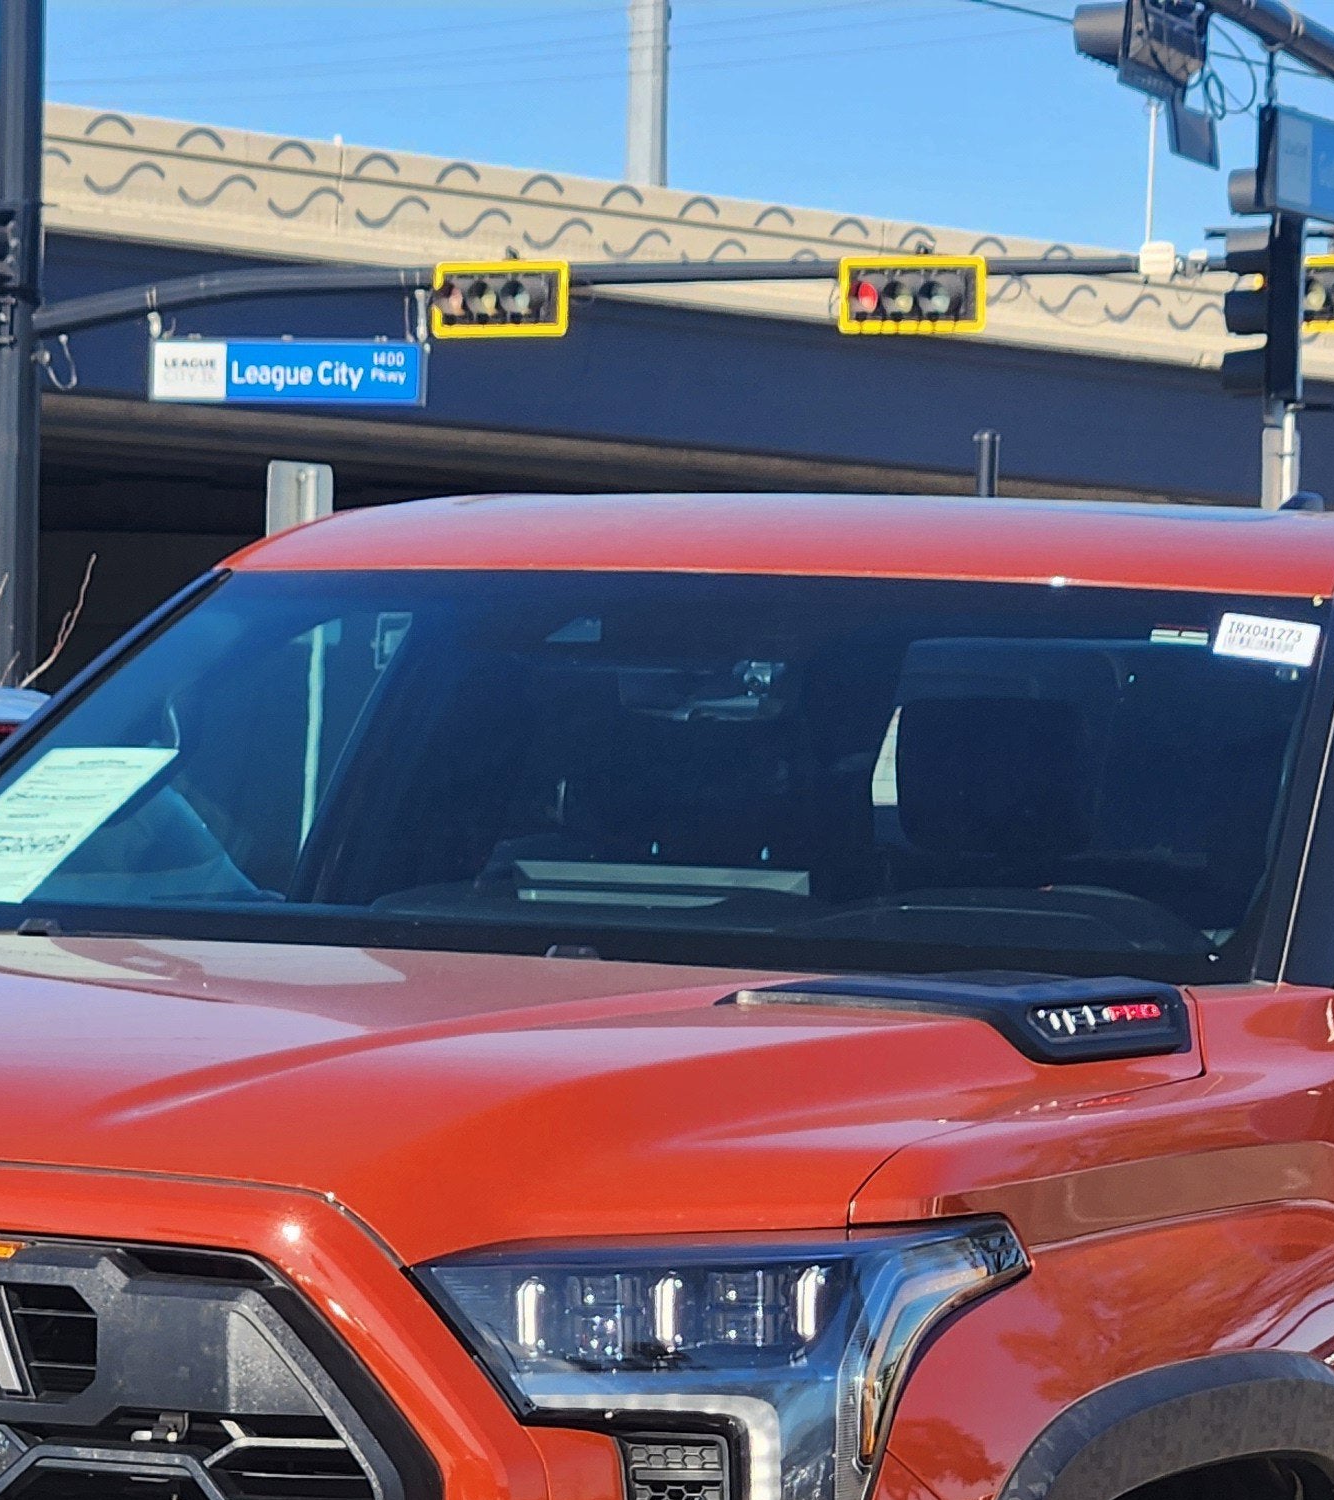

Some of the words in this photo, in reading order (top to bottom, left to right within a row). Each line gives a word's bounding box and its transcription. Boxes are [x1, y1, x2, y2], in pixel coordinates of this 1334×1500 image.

[164, 358, 216, 369] LEAGUE
[372, 351, 405, 367] 1400
[232, 360, 313, 391] League
[317, 361, 364, 391] City
[370, 367, 406, 385] Pkwy
